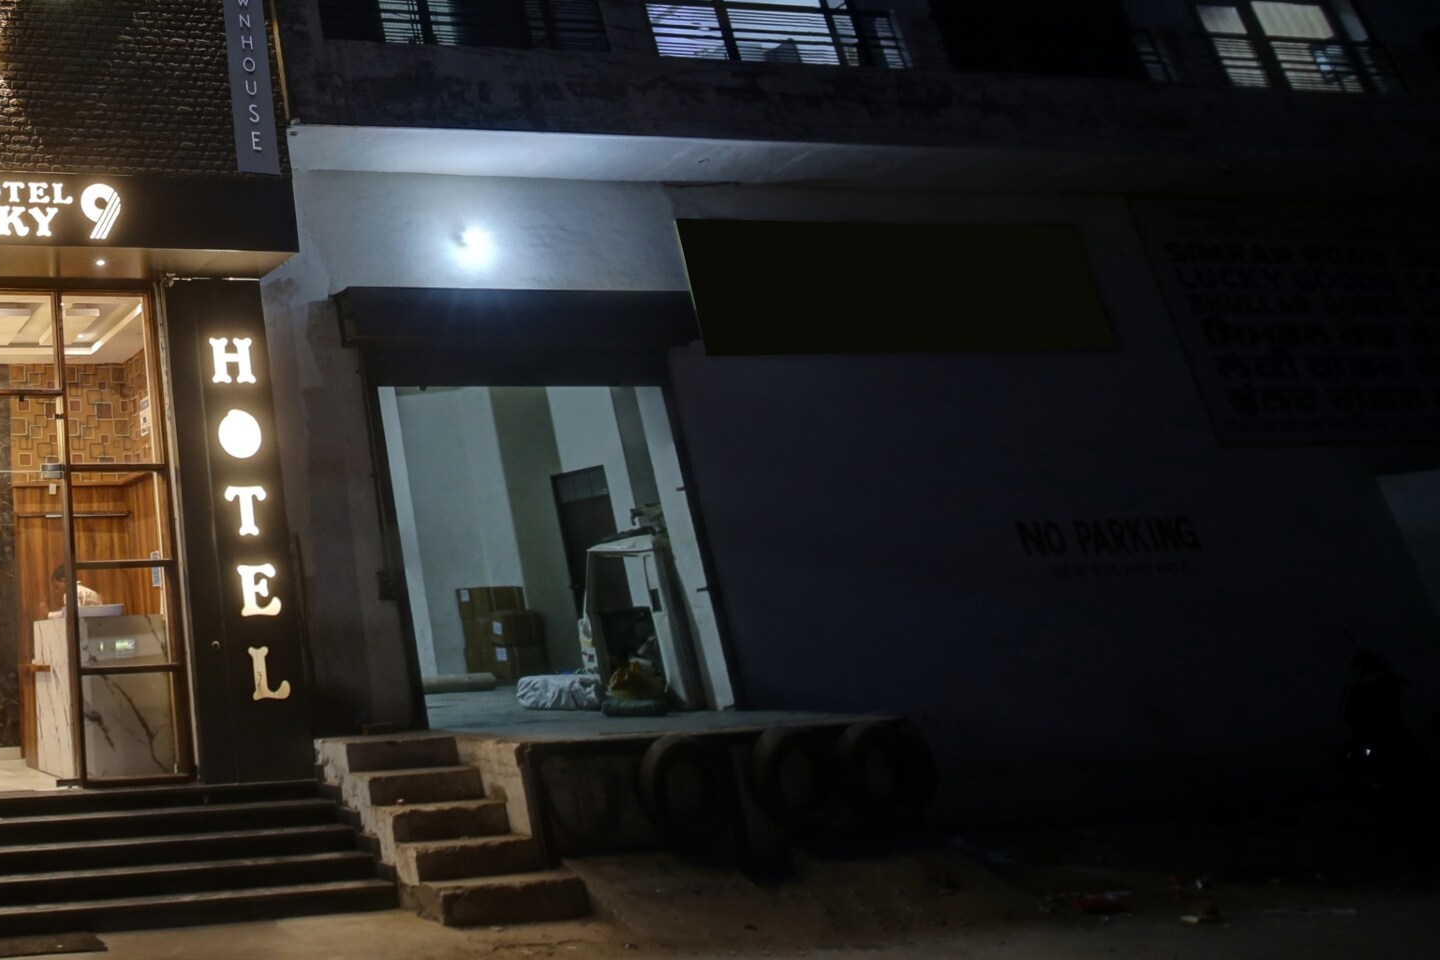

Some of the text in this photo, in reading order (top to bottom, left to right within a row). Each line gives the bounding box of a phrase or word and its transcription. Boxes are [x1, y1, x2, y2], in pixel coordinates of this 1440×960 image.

[80, 183, 122, 240] 9
[1174, 266, 1283, 291] LUCKY
[208, 336, 291, 701] HOTEL
[1015, 515, 1202, 557] NO PARKING
